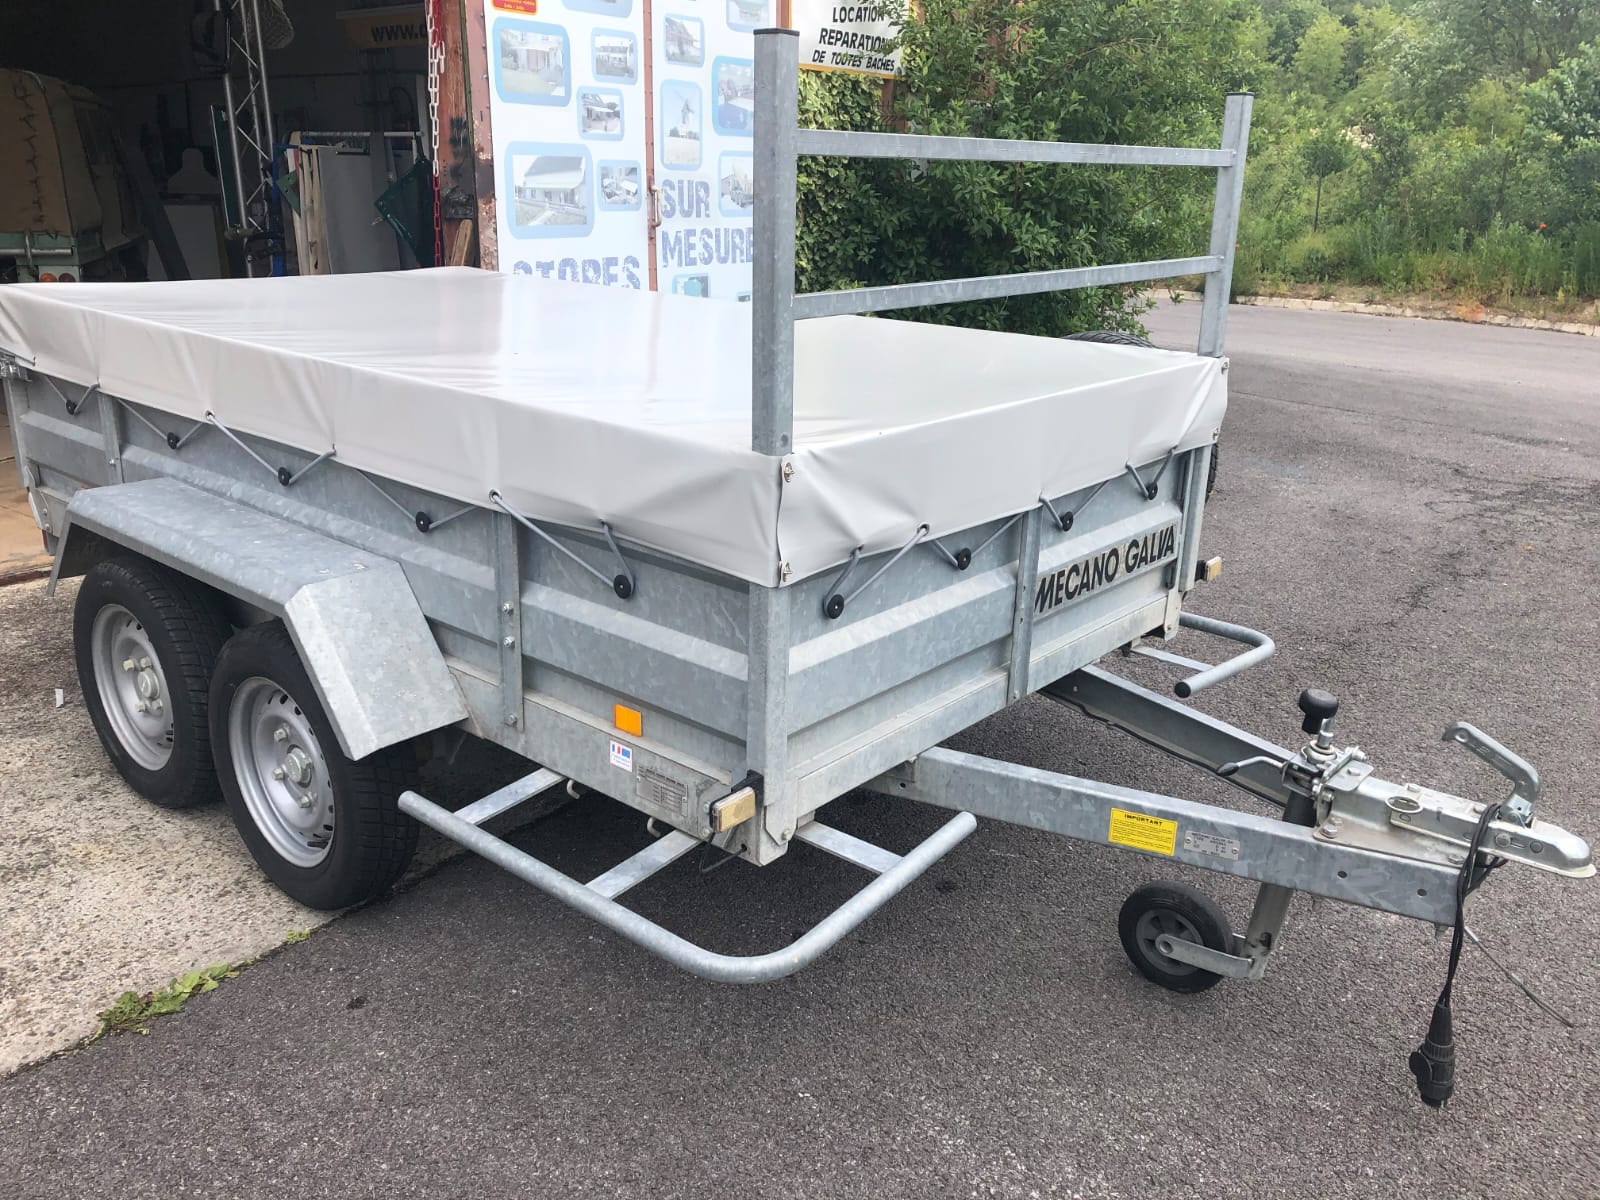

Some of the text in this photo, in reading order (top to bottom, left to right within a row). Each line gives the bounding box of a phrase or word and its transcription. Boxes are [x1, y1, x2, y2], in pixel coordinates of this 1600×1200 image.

[812, 49, 826, 63] DE
[866, 57, 895, 72] BACHES
[661, 179, 710, 218] SUR
[1034, 525, 1175, 613] MECANO GALVA
[1124, 813, 1163, 827] IMPORTANT
